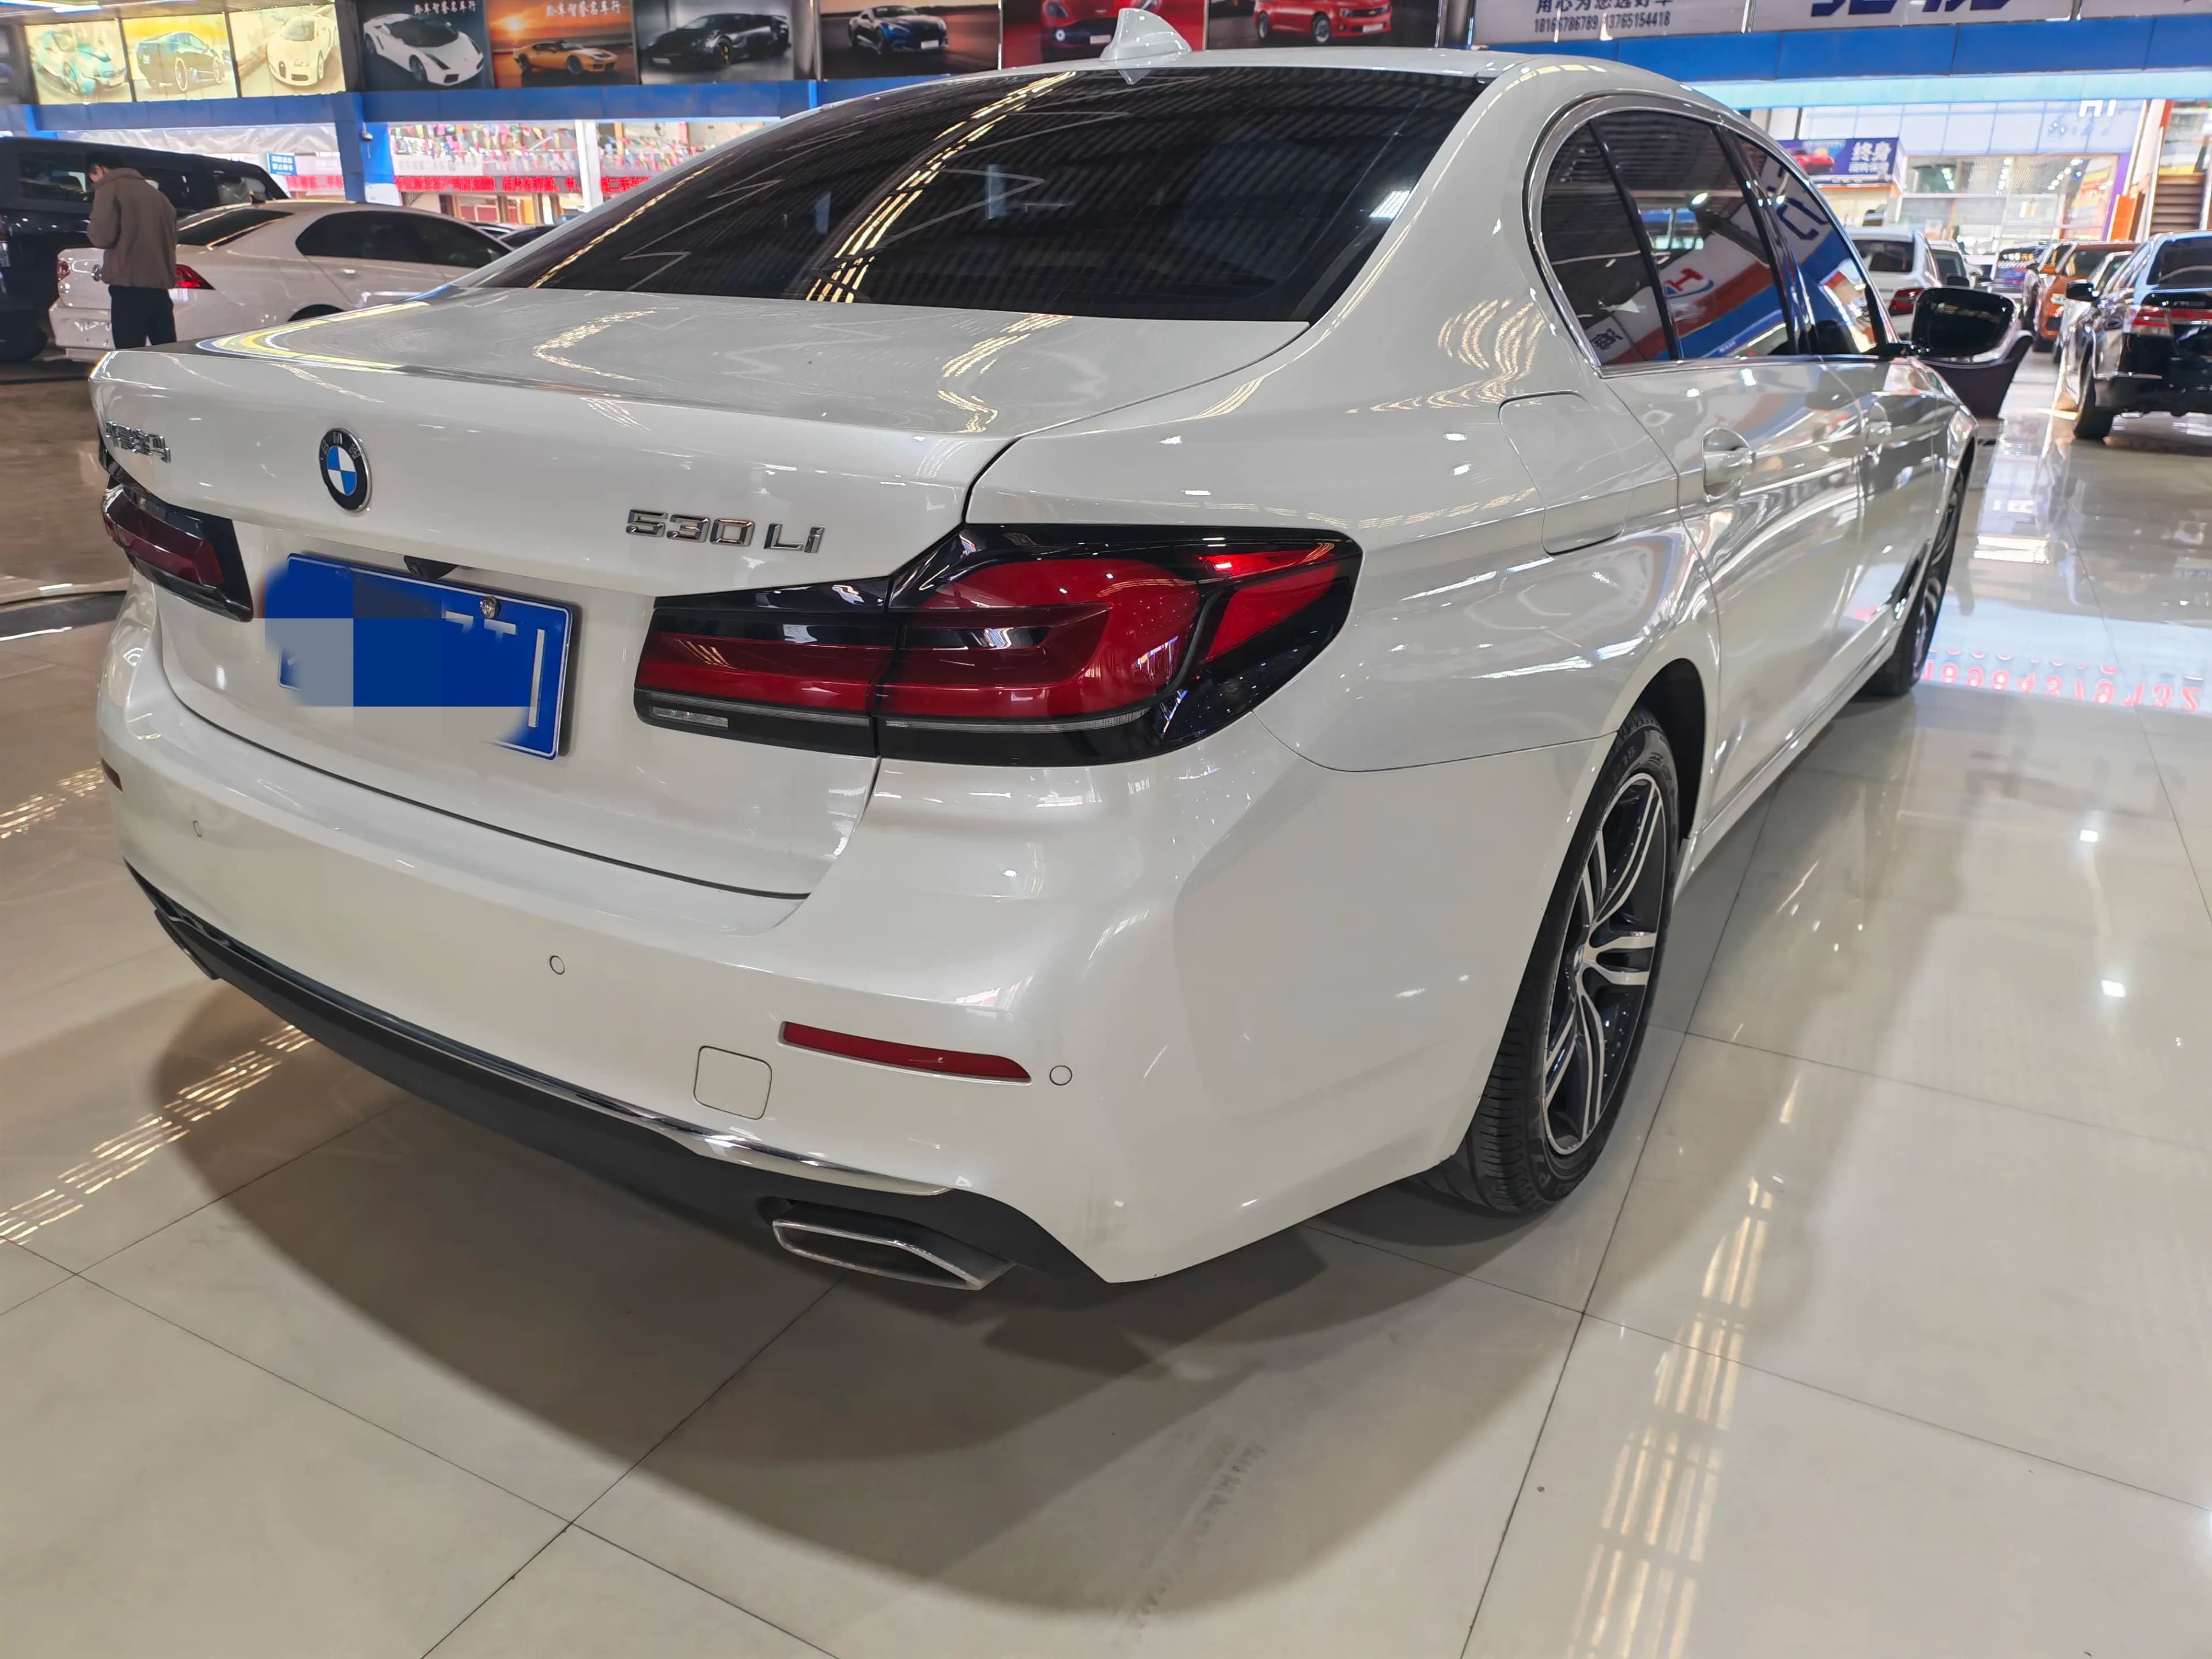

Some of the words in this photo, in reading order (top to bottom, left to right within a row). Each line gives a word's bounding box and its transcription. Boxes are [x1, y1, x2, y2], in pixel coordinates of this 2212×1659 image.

[321, 431, 361, 460] BMW
[625, 508, 756, 548] 530
[763, 522, 825, 554] Li
